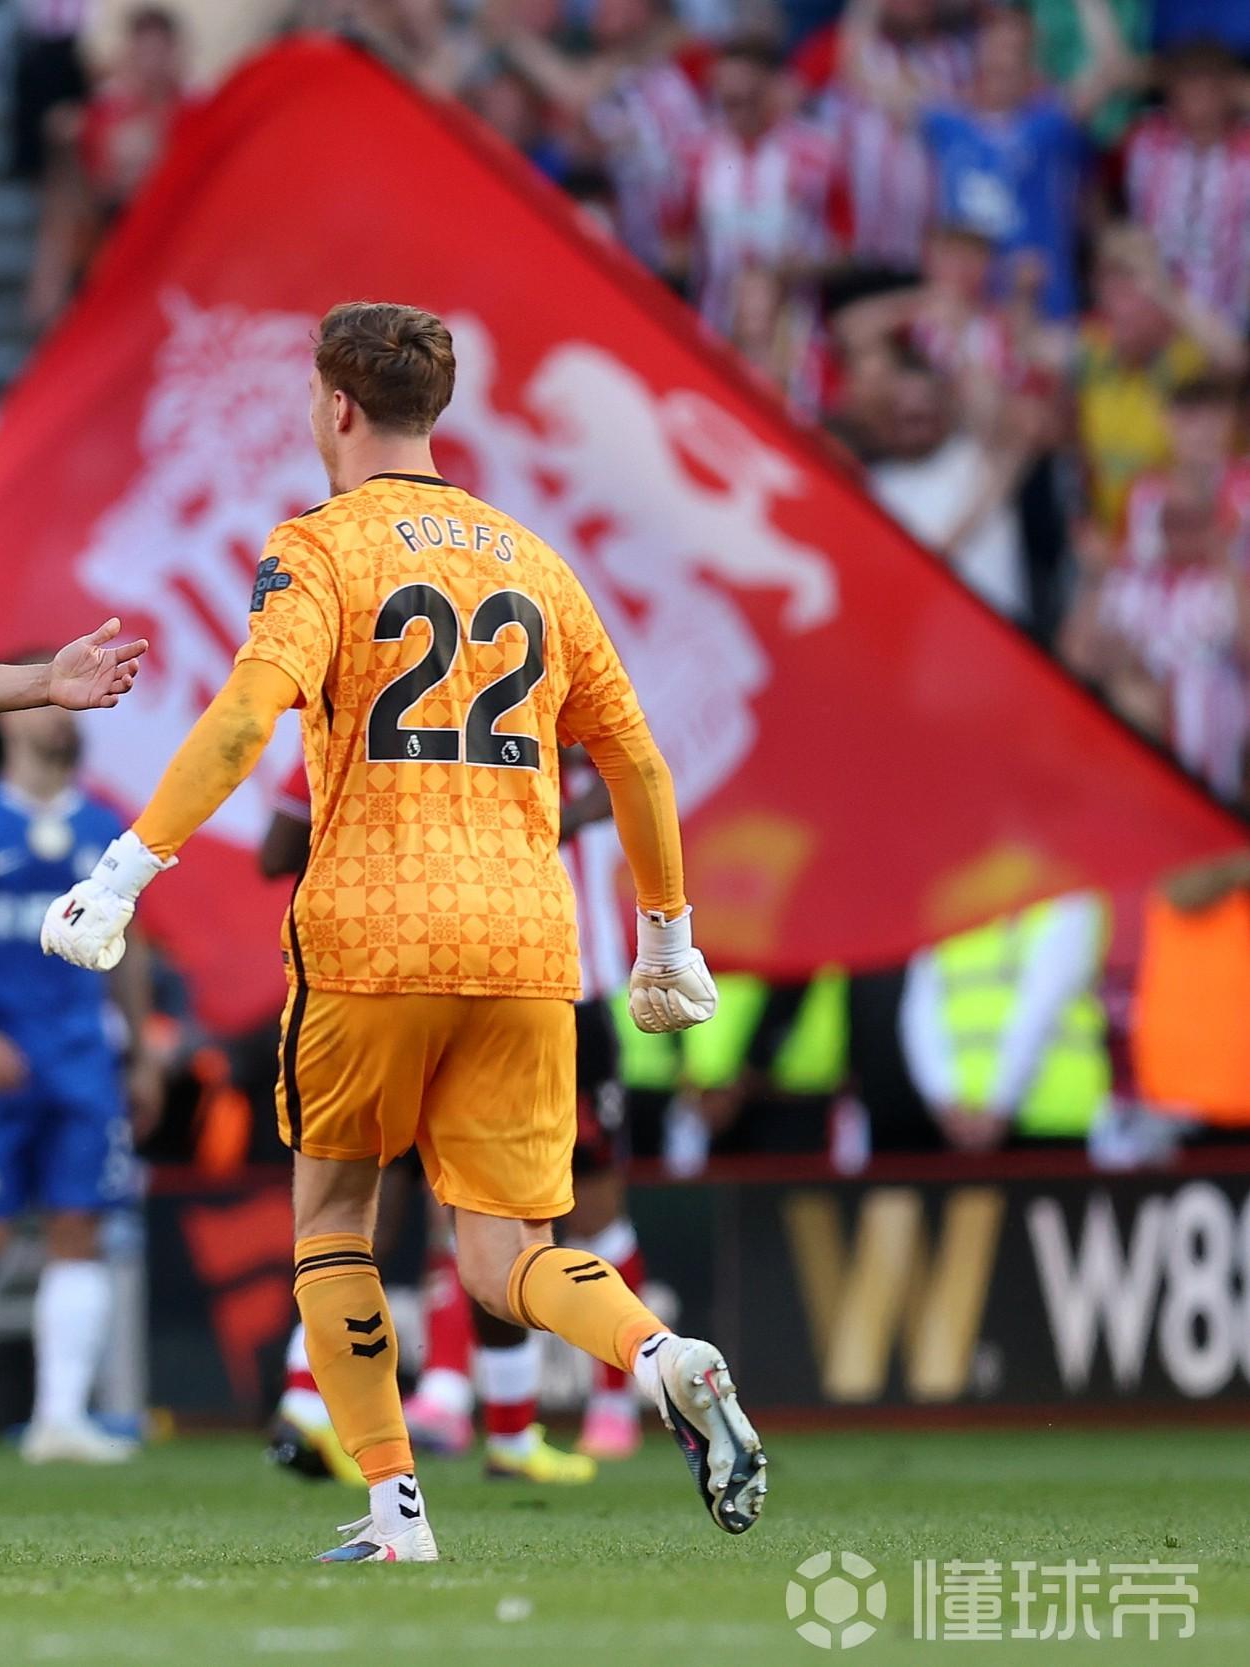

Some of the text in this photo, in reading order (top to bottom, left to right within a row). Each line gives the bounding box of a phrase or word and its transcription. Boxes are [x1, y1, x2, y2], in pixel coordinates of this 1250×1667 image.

[395, 516, 515, 562] ROEFS
[366, 582, 547, 771] 22
[785, 1182, 1250, 1400] W W8
